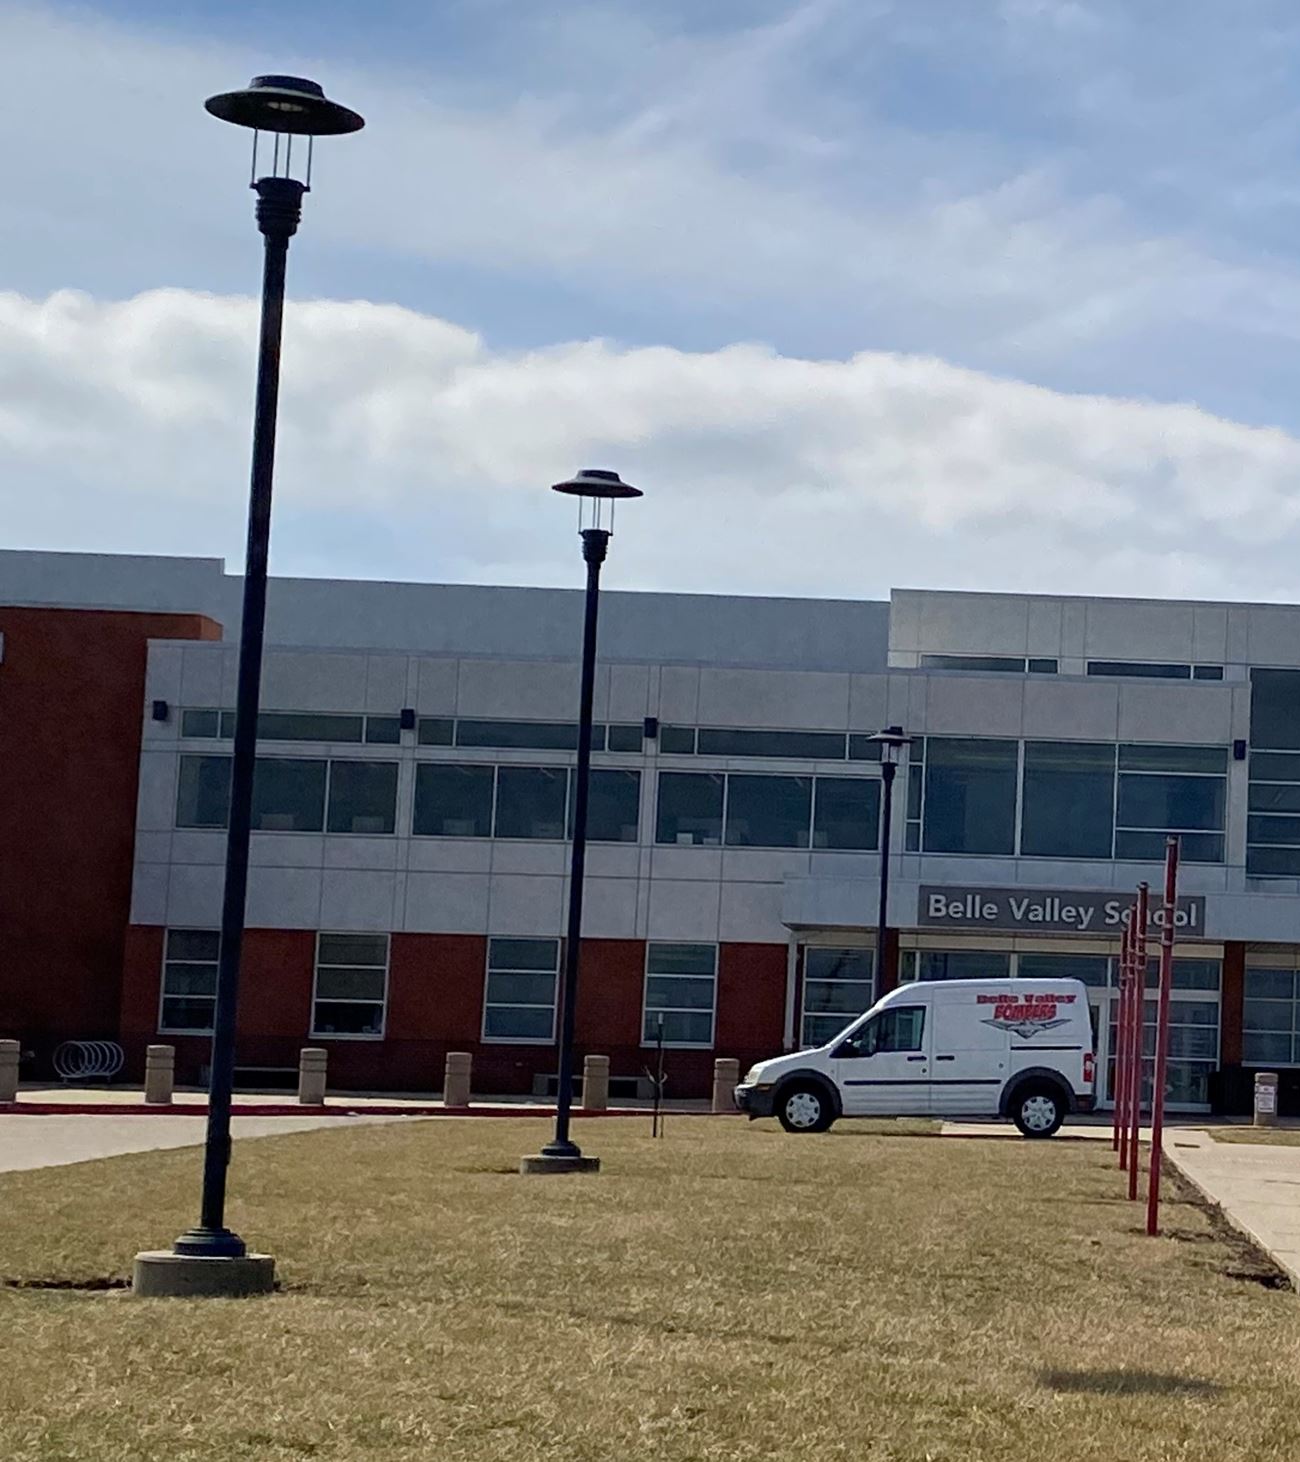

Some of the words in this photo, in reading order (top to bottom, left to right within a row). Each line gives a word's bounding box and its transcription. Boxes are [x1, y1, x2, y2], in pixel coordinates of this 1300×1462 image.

[928, 894, 998, 919] Belle
[1009, 897, 1094, 929] Valley
[1023, 993, 1077, 1004] Valley
